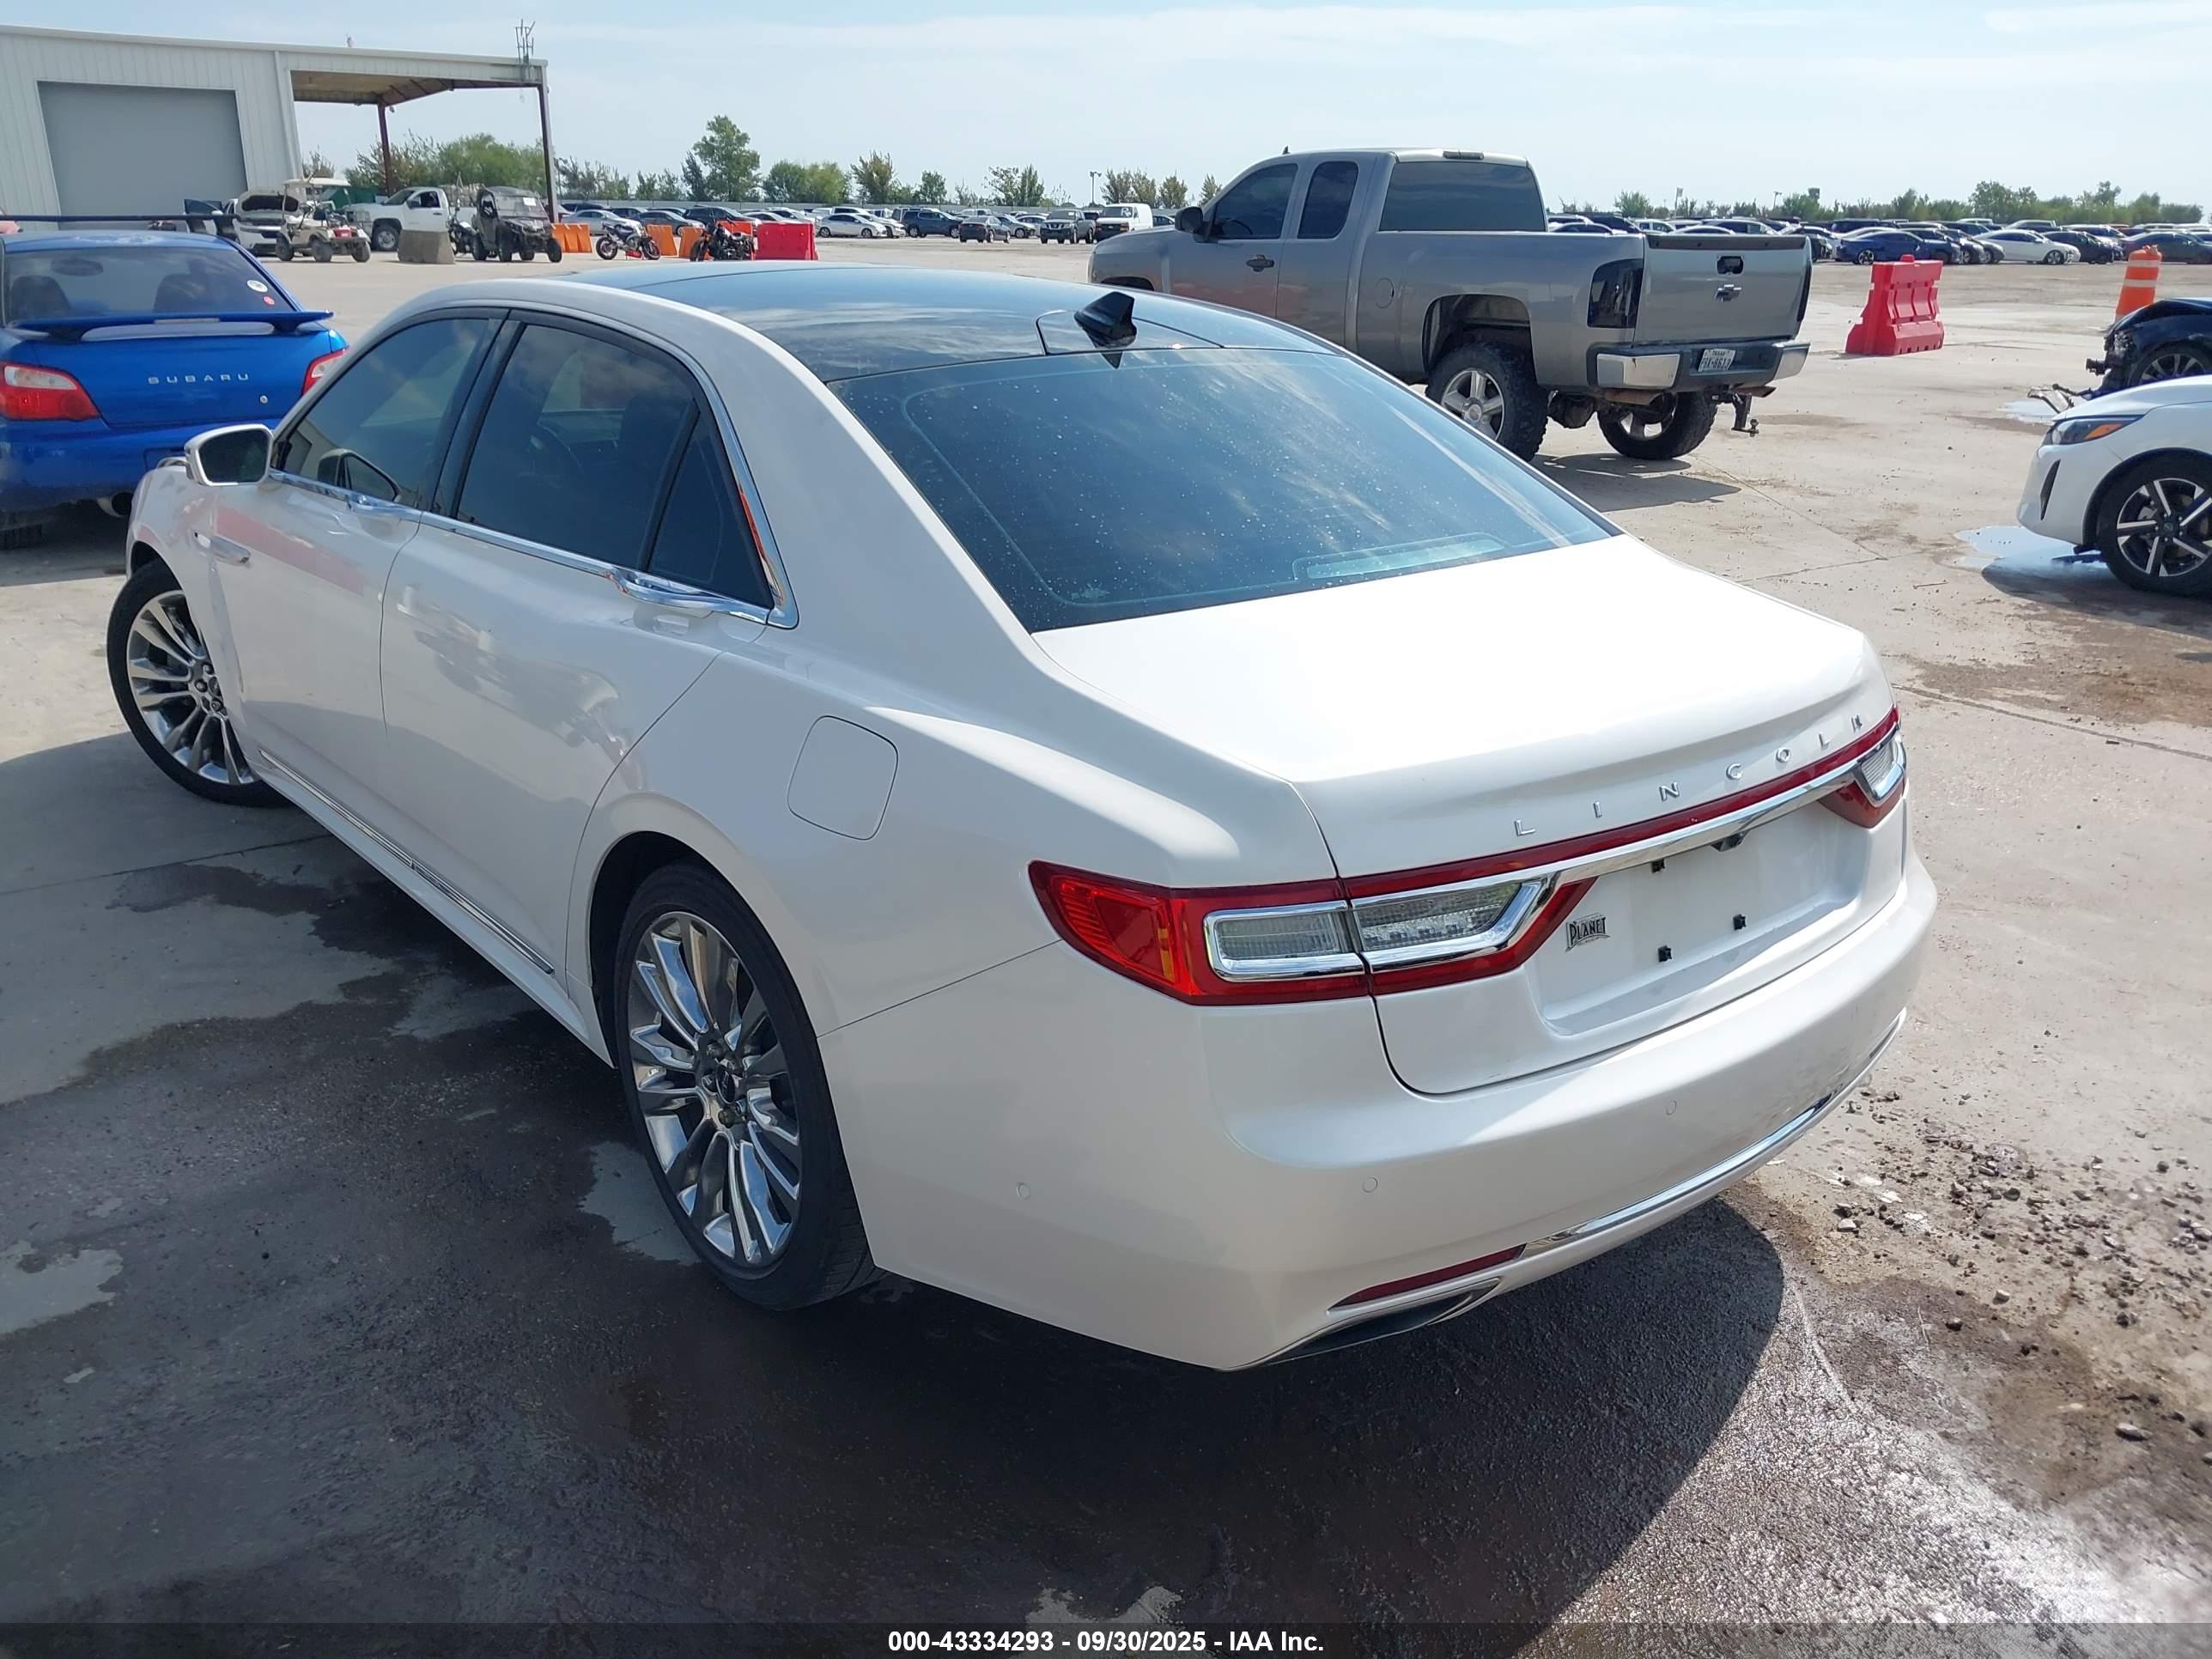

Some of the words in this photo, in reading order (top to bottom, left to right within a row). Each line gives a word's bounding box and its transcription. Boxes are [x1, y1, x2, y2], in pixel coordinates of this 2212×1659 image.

[147, 373, 250, 385] SUBARU
[1513, 714, 1863, 837] LINCOLN
[1569, 916, 1607, 946] PLANET
